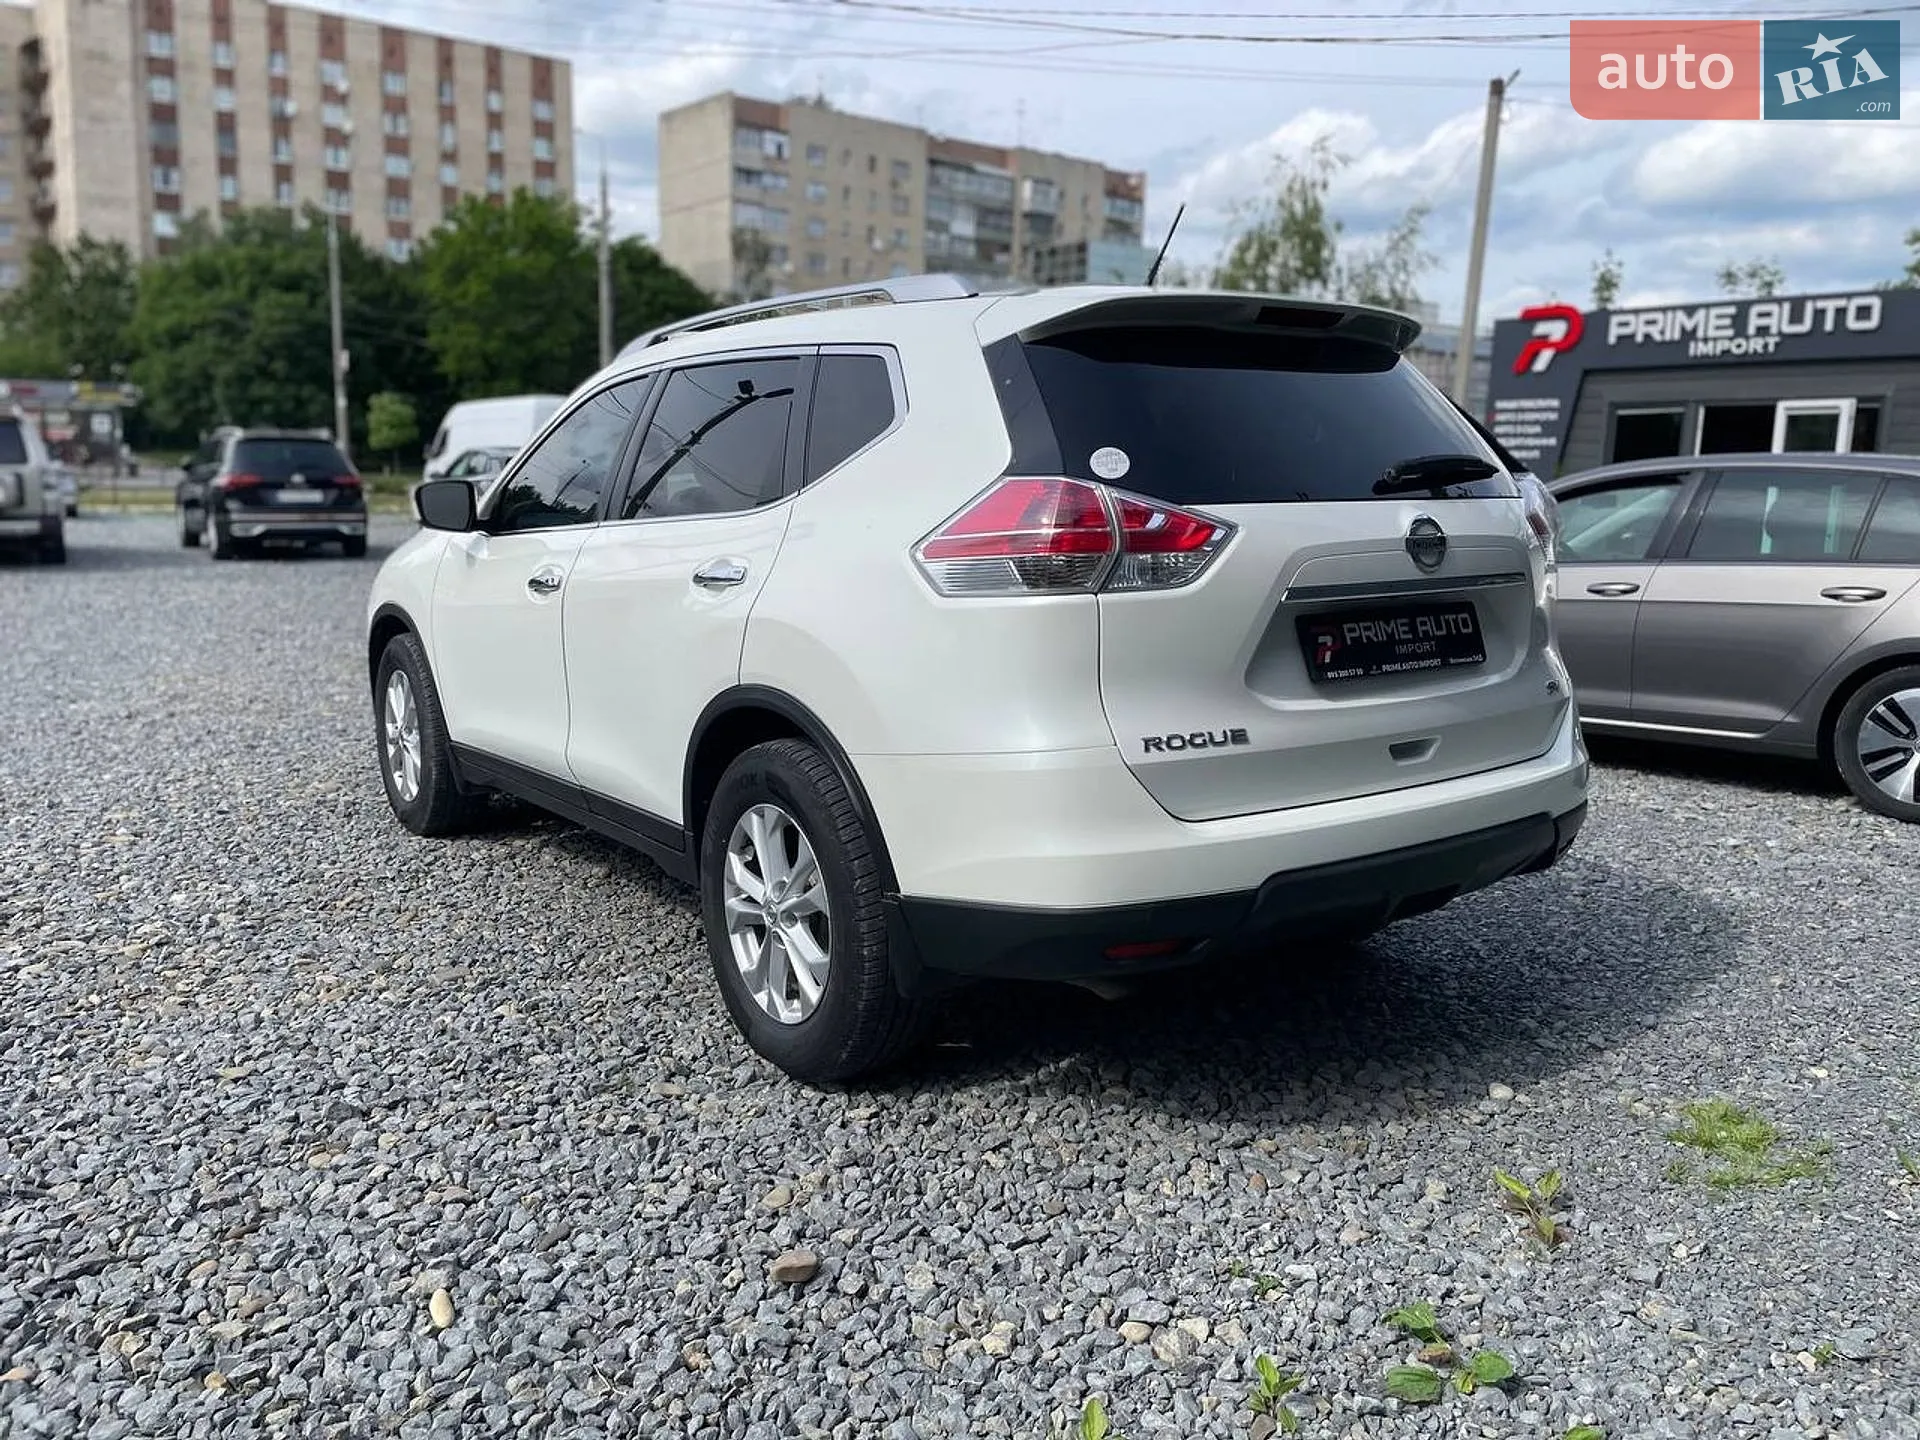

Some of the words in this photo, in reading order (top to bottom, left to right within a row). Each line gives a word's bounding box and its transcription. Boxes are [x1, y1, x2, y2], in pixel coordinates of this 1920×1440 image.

[1608, 305, 1738, 345] PRIME
[1746, 295, 1882, 335] AUTO
[1688, 336, 1781, 357] IMPORT
[1342, 617, 1413, 645] PRIME
[1416, 613, 1473, 638] AUTO
[1395, 640, 1436, 655] IMPORT
[1141, 727, 1251, 753] ROGUE
